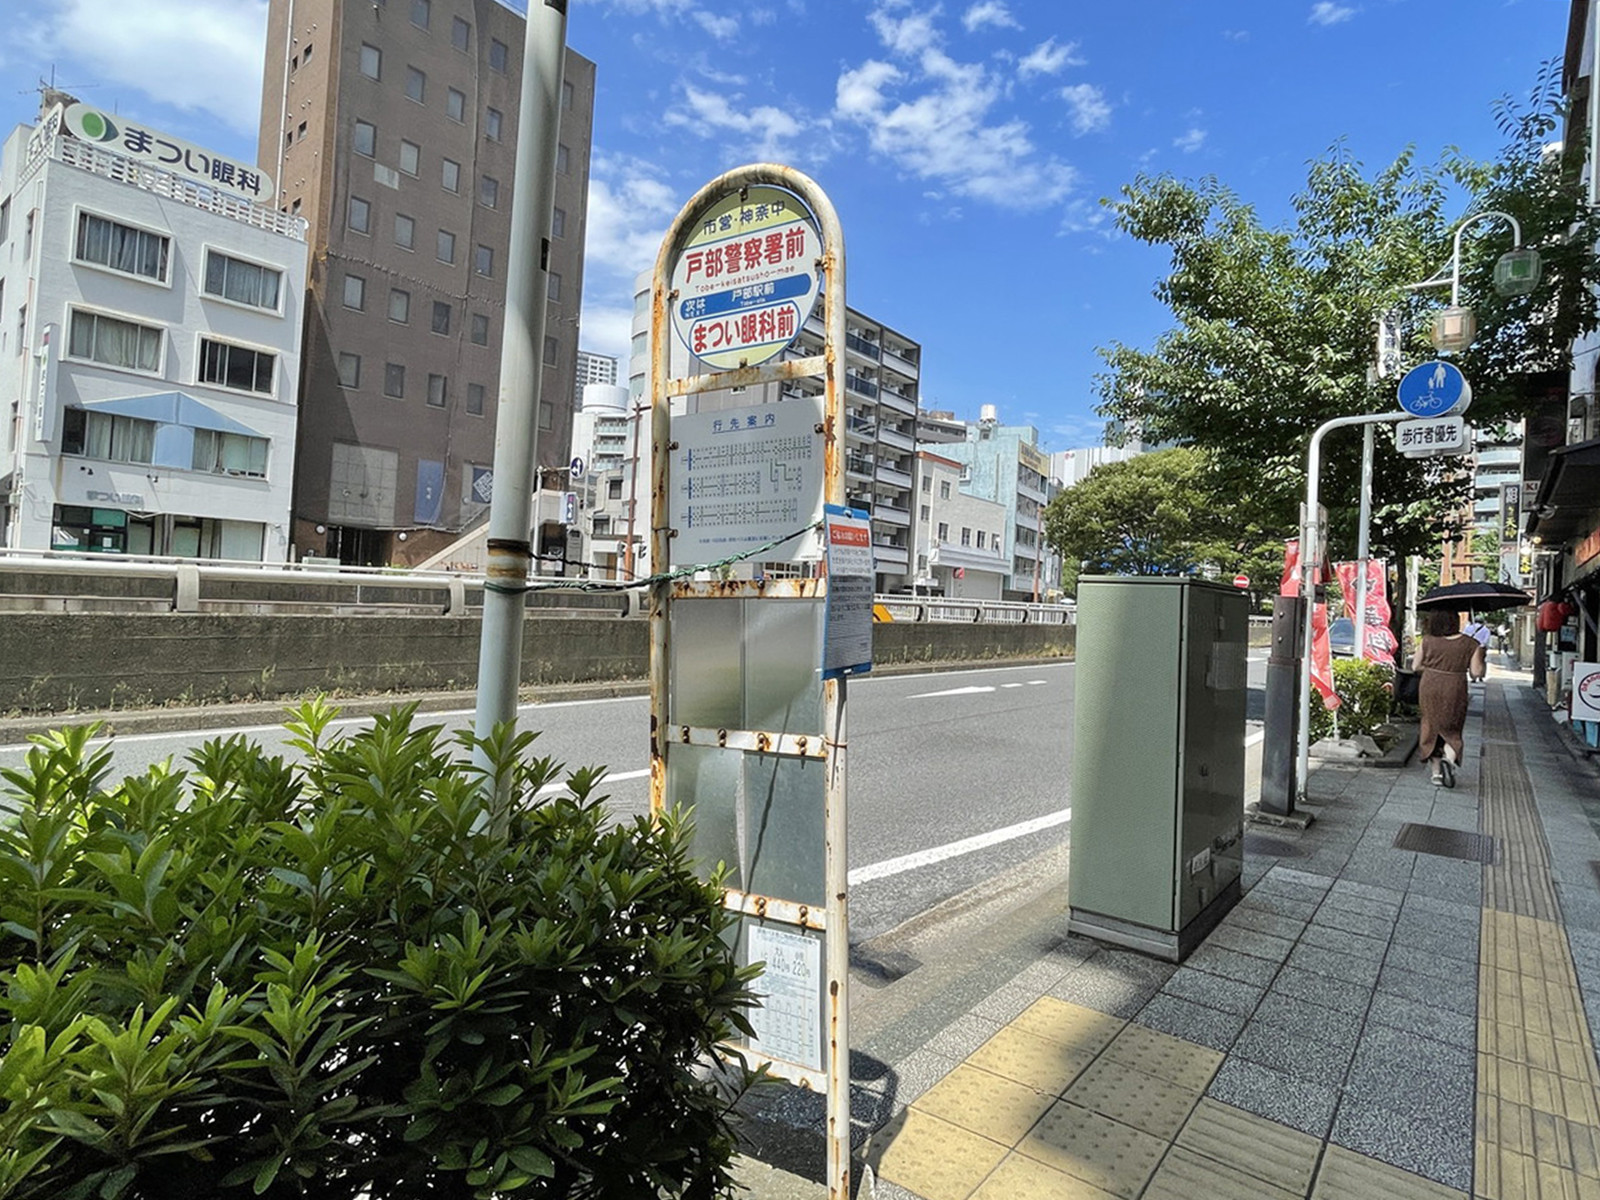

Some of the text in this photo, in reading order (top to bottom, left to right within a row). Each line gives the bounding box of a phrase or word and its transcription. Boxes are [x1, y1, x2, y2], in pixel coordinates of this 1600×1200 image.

[123, 126, 261, 197] まつい眼科
[703, 200, 785, 235] 市営・神奈中
[686, 227, 804, 283] 戸部警察署前
[685, 282, 775, 312] 次は 戸部駅前
[693, 305, 795, 353] まつい眼科前
[712, 413, 776, 431] 行先案内
[1402, 424, 1458, 446] 歩行者優先
